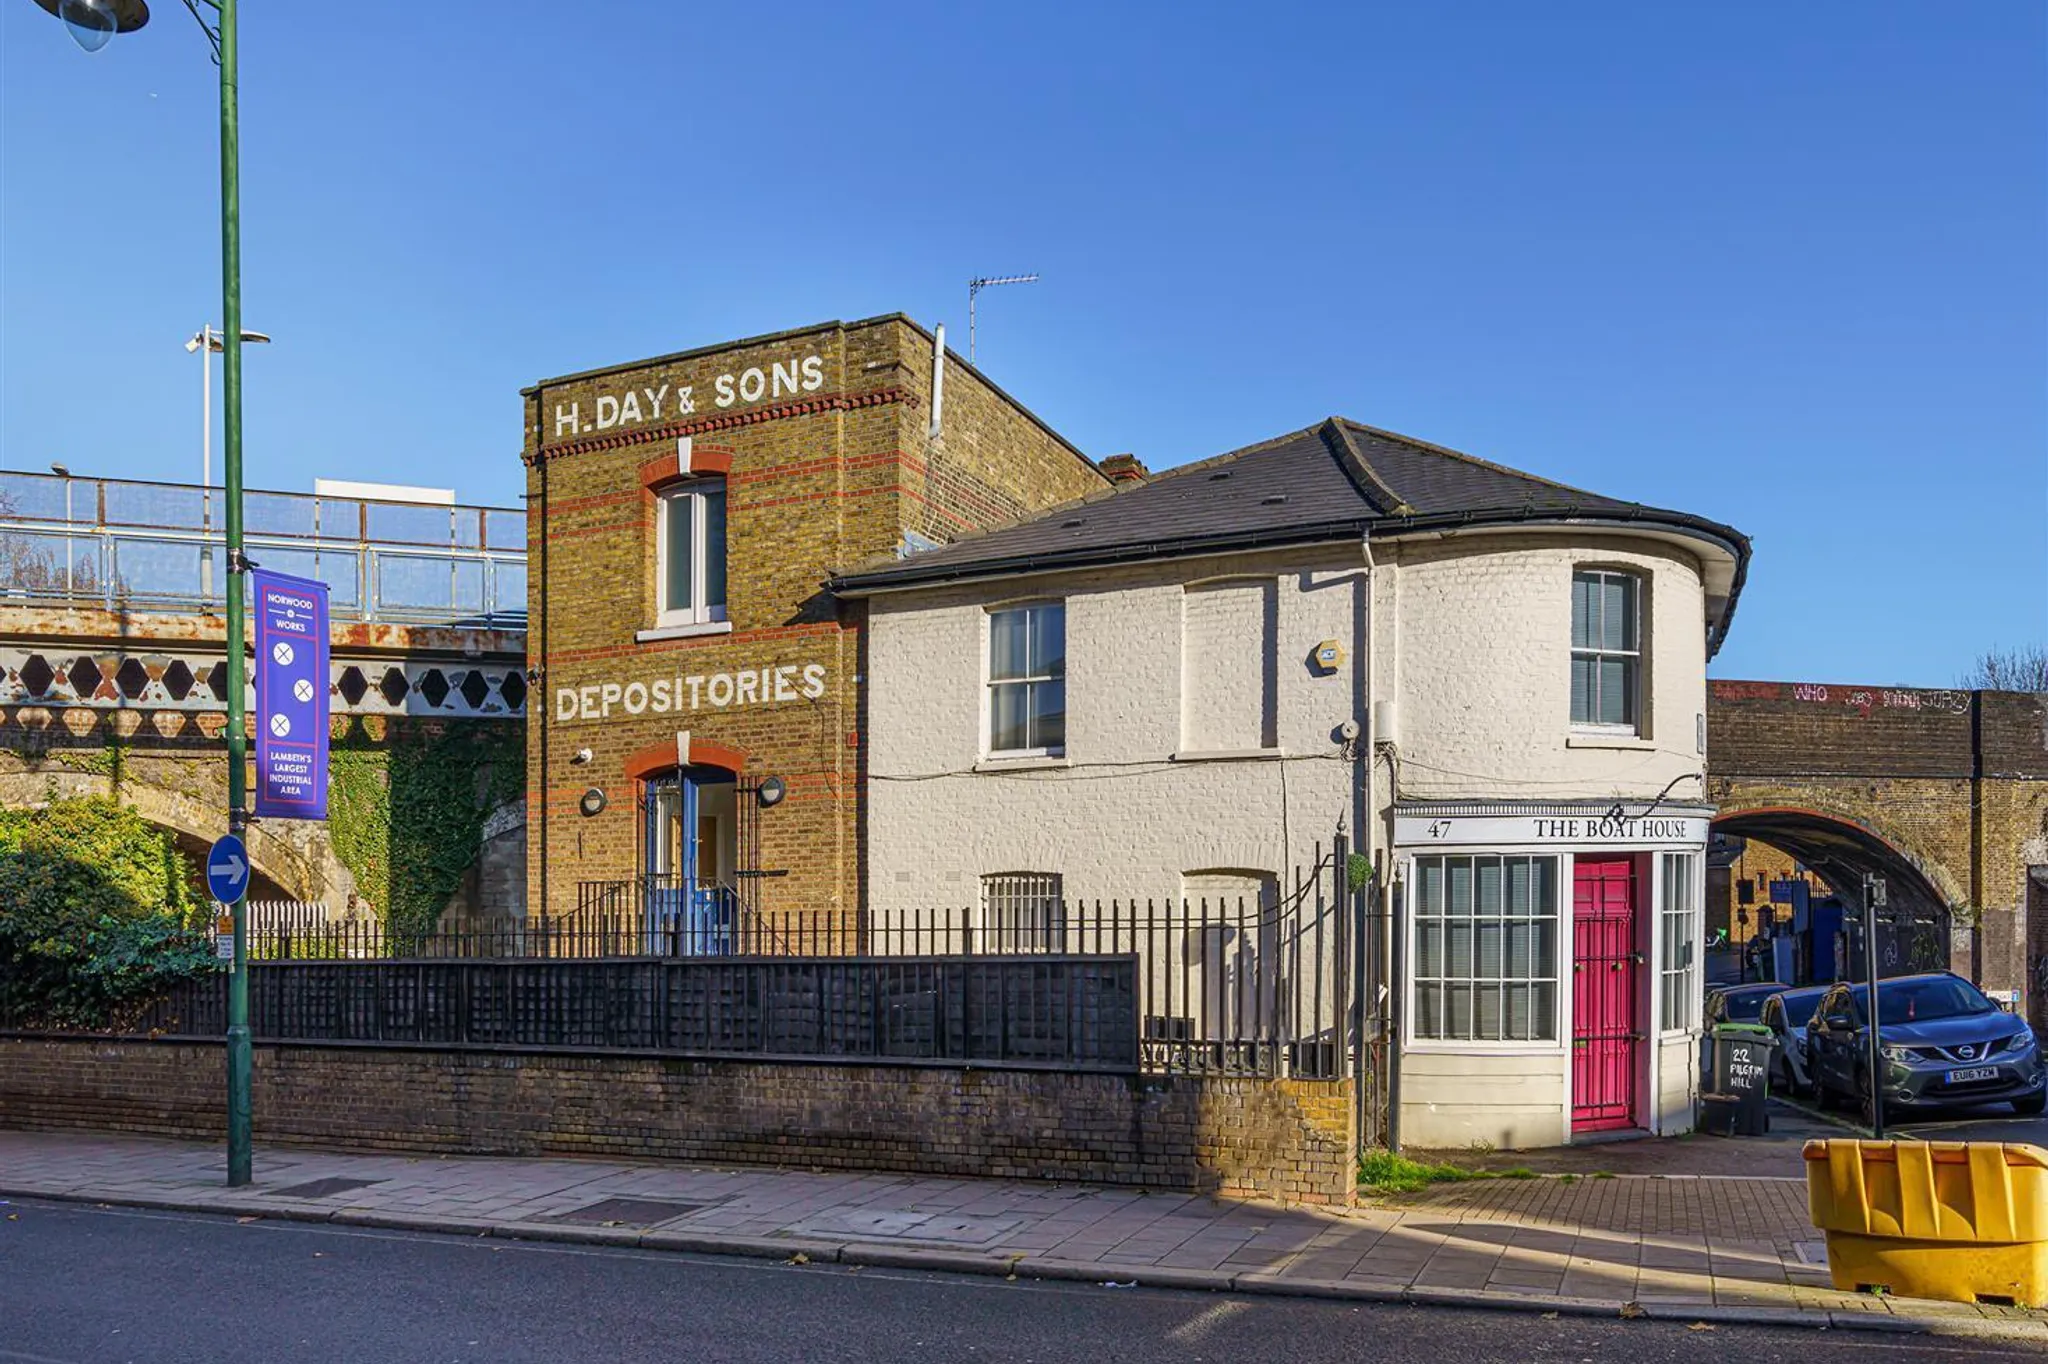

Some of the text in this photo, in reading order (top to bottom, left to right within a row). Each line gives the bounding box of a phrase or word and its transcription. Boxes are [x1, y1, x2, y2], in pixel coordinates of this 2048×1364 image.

[677, 386, 695, 416] &
[714, 355, 824, 408] SONS
[267, 593, 313, 610] NORWOOD
[276, 619, 306, 632] WORKS
[556, 664, 826, 721] DEPOSITORIES
[1793, 683, 1828, 702] WHO
[270, 751, 312, 764] LAMBETH'S
[274, 763, 308, 774] LARGEST
[269, 773, 312, 786] INDUSTRIAL
[280, 785, 302, 796] AREA
[1427, 820, 1453, 838] 47
[1533, 819, 1687, 838] THE BOAT HOUSE
[1732, 1048, 1751, 1063] 22
[1953, 1070, 1975, 1081] EU16
[1731, 1077, 1753, 1090] HILL
